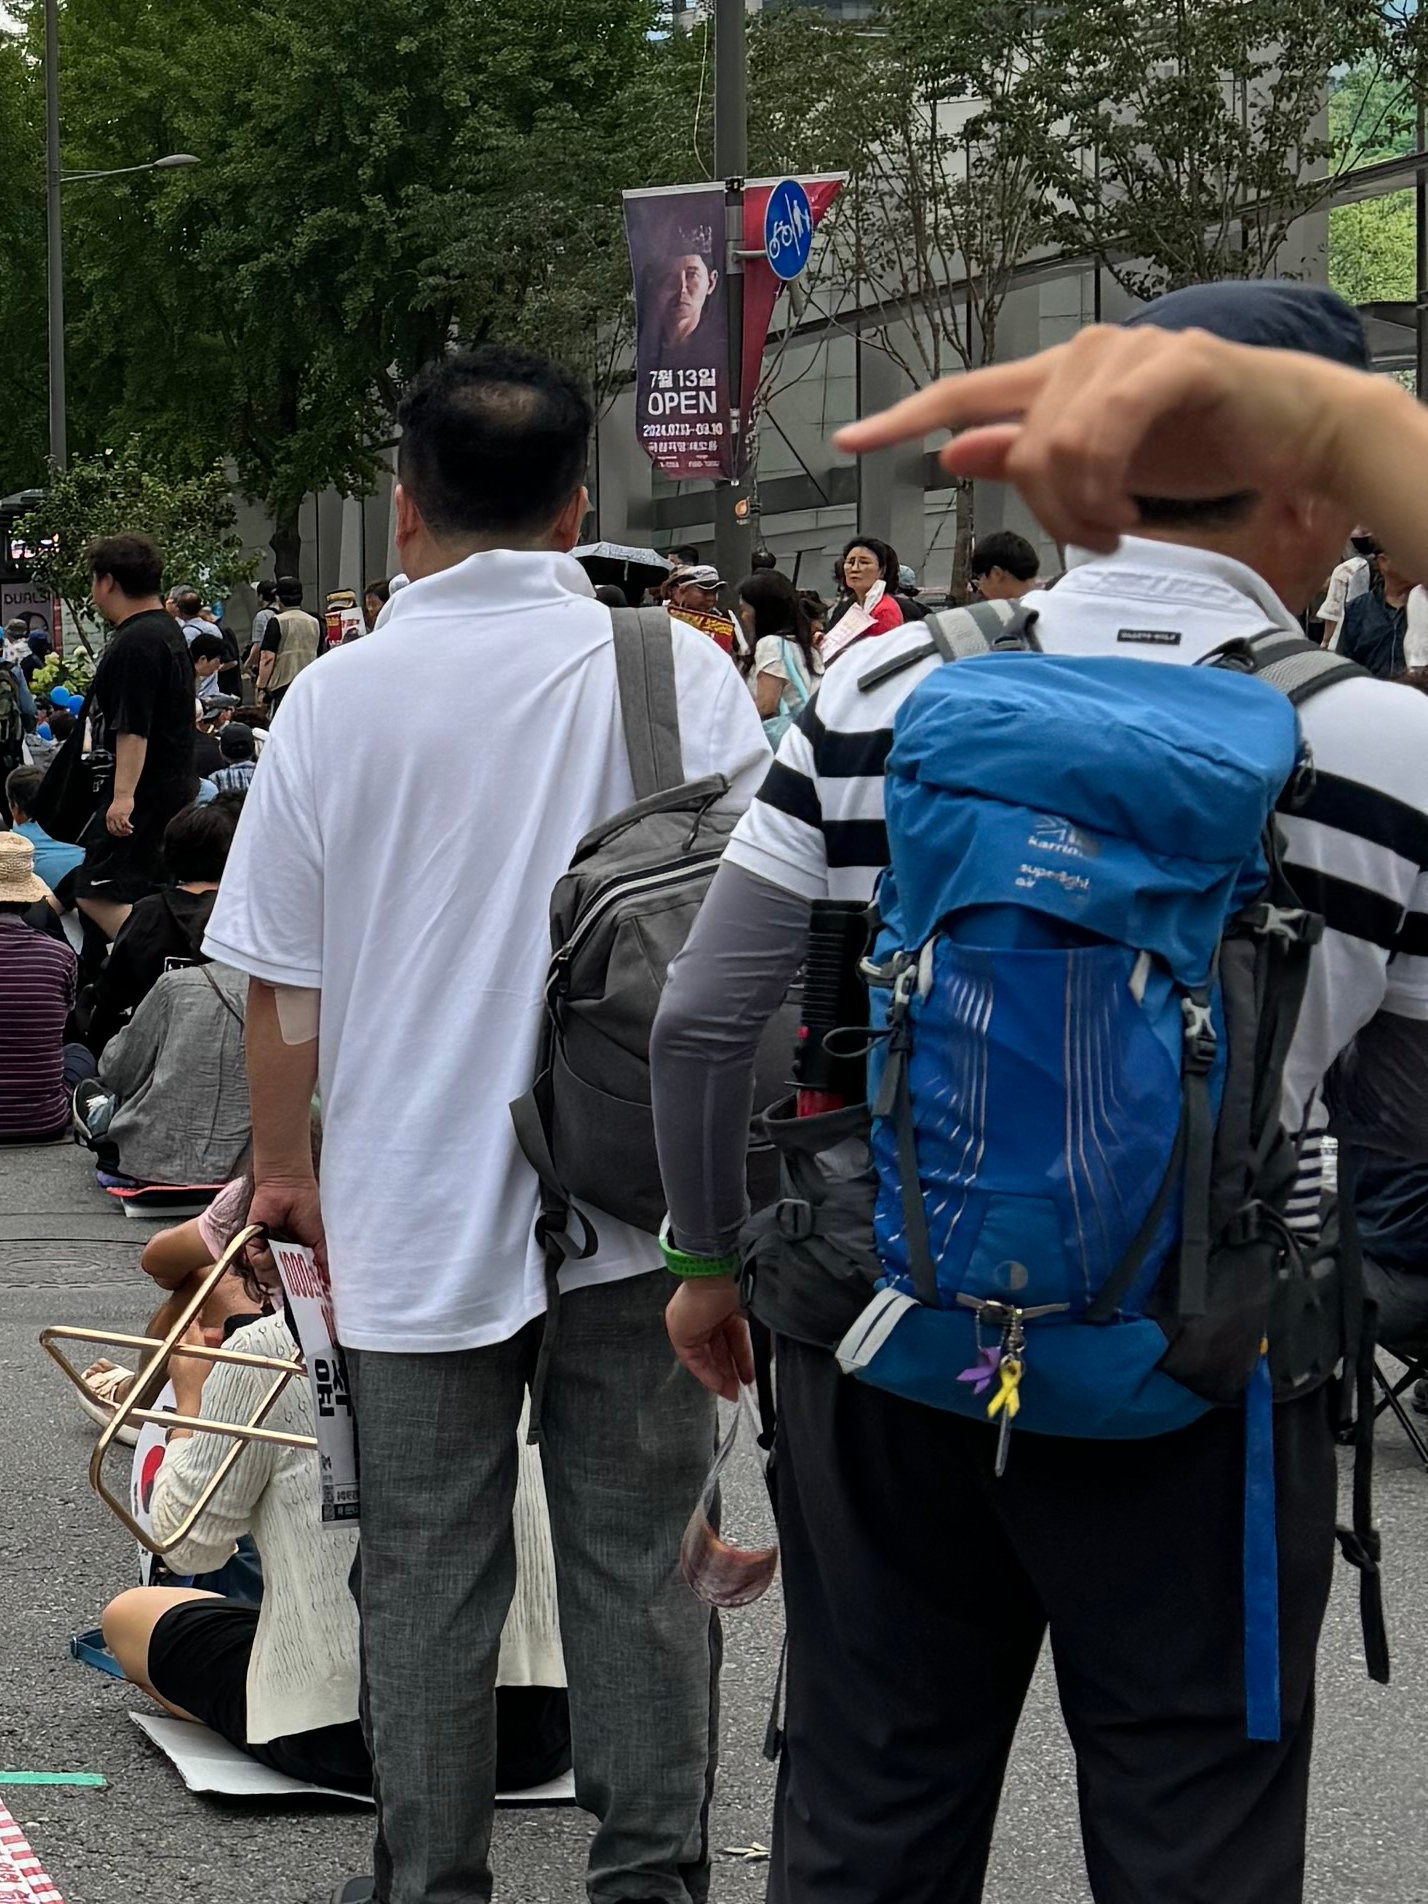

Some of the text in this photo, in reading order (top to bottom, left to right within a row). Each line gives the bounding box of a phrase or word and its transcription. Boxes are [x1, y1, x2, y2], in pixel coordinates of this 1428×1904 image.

[649, 367, 717, 389] 7월 13일
[647, 391, 718, 416] OPEN
